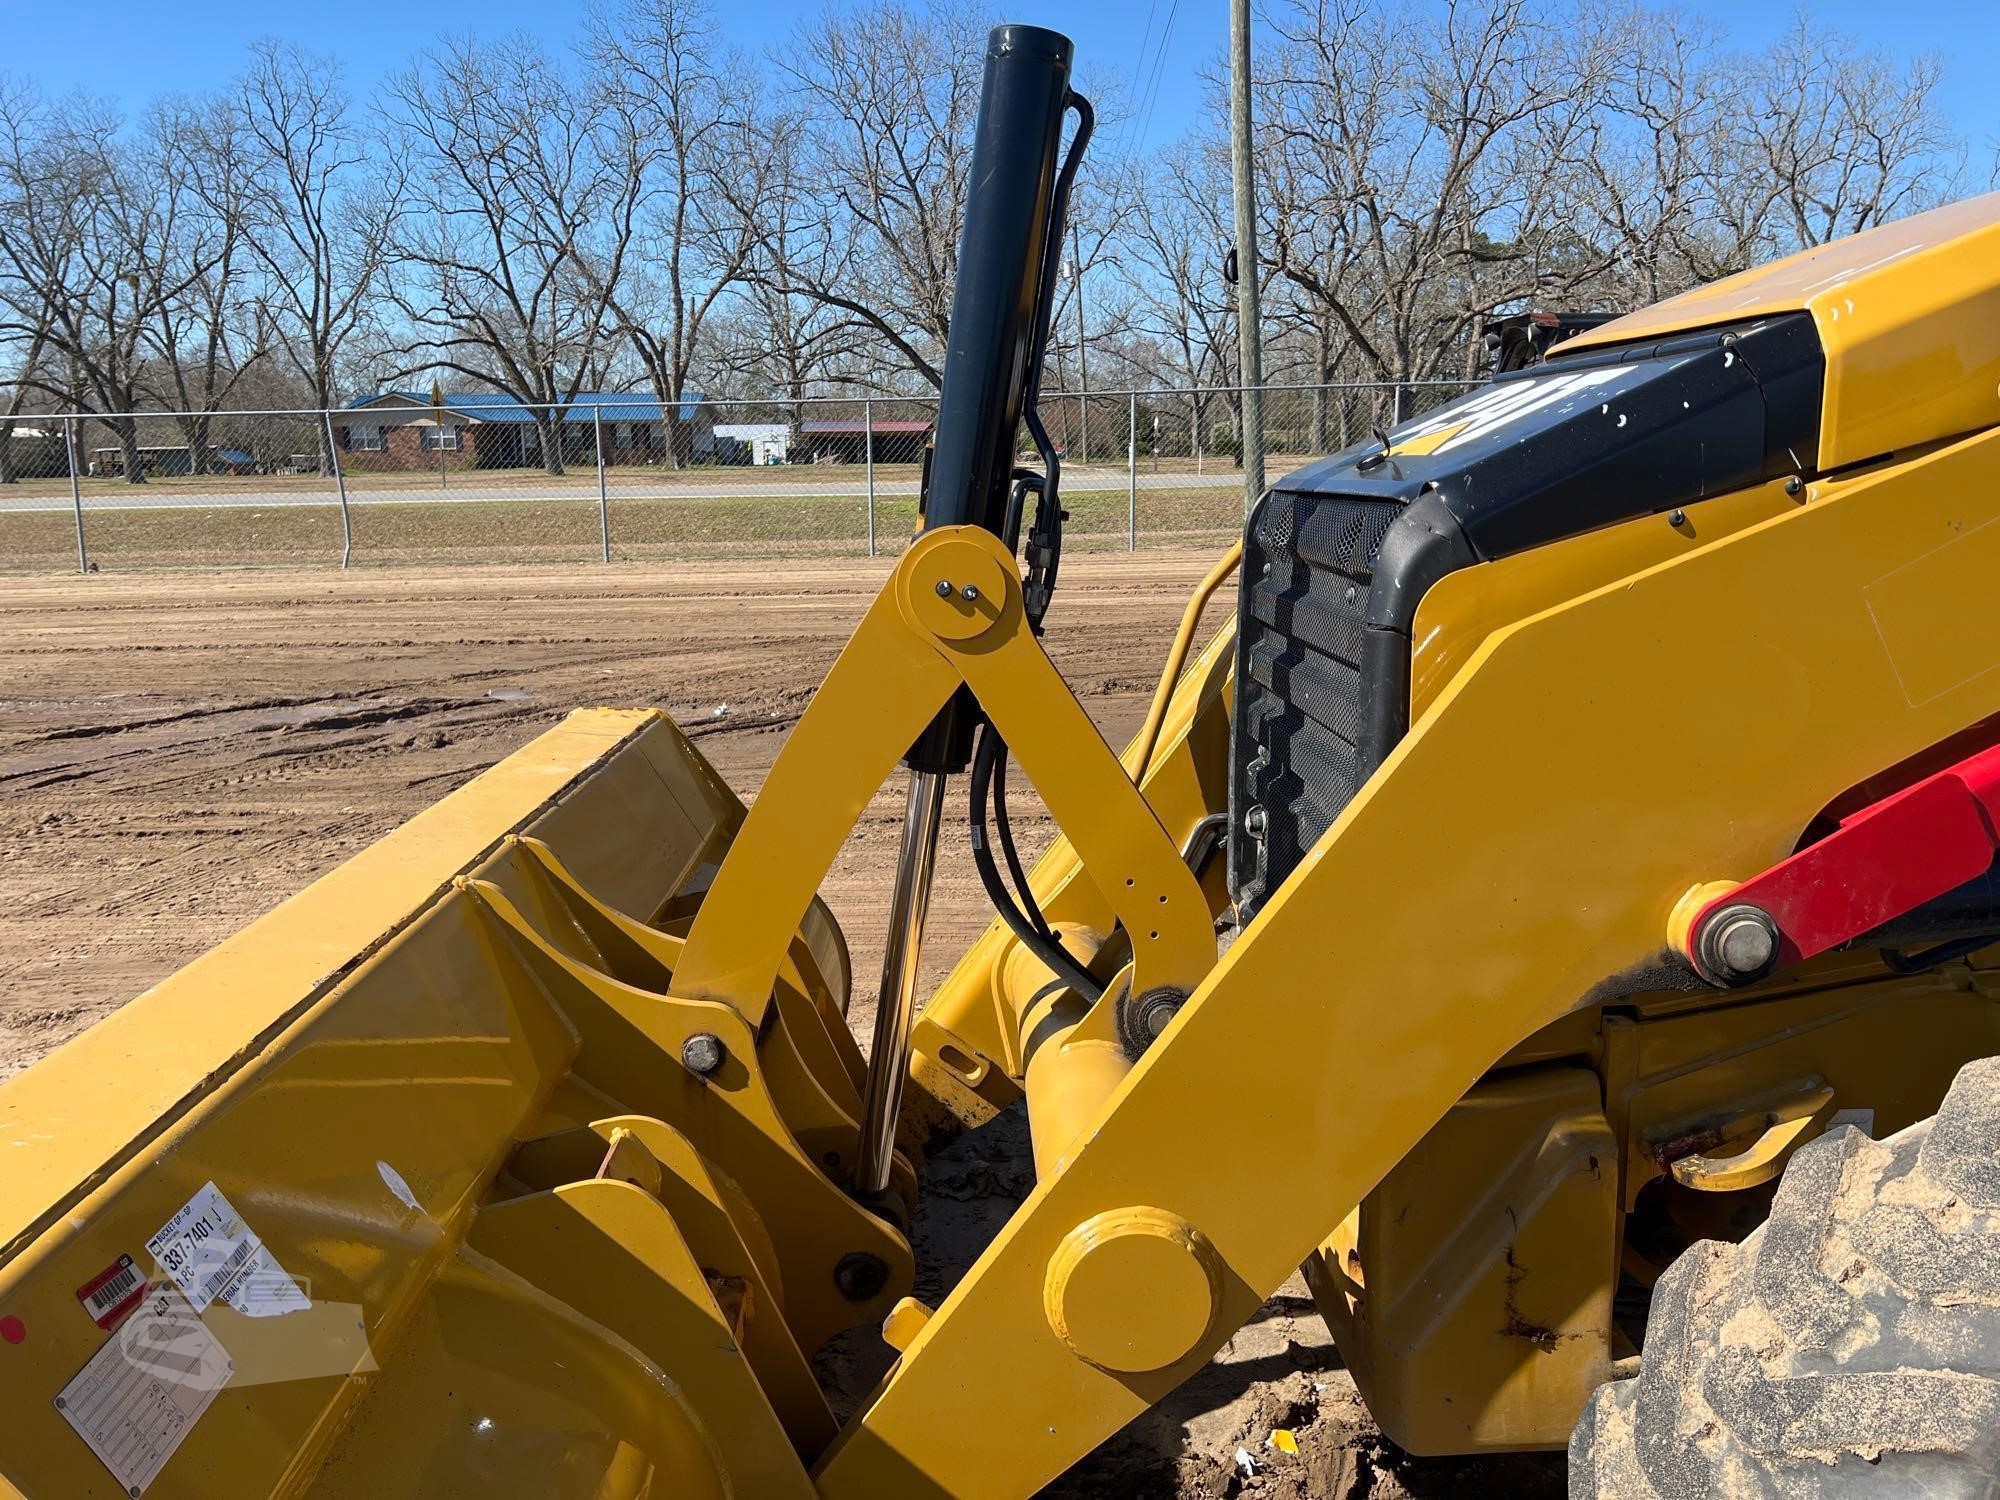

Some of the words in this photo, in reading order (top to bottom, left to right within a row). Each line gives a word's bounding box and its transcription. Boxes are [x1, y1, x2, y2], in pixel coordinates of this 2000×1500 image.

[156, 1222, 176, 1243] BUCKET
[164, 1216, 214, 1271] 337-7401
[176, 1278, 184, 1287] 1
[181, 1265, 195, 1281] PC
[236, 1259, 259, 1286] NUMBER
[154, 1296, 170, 1316] CAT
